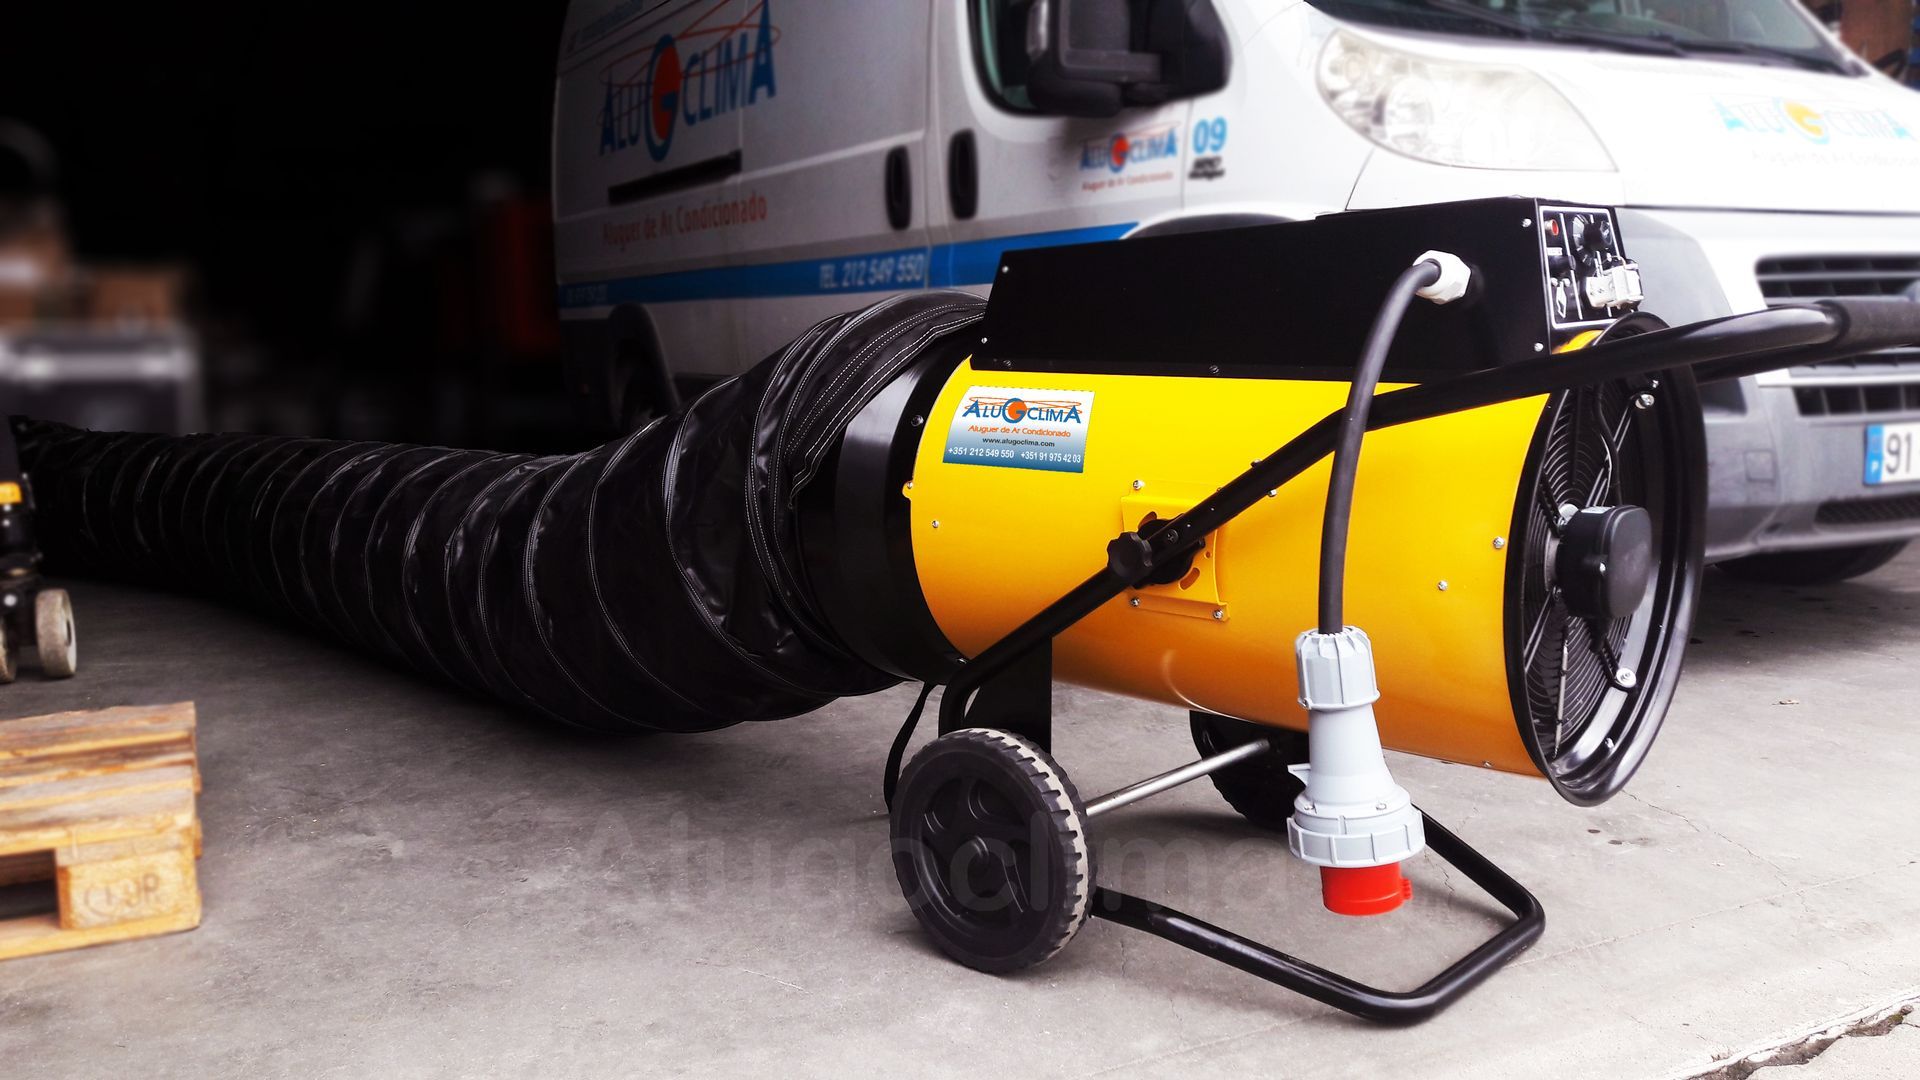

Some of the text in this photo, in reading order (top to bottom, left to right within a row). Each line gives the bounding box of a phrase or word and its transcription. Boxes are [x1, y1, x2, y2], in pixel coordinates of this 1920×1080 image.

[1193, 116, 1227, 154] 09
[841, 258, 867, 287] 212
[895, 253, 924, 283] 550
[968, 425, 1071, 438] Aluguer de Ar Condicionado
[982, 437, 1055, 448] www.alugoclima.com
[948, 447, 968, 456] +351
[970, 448, 984, 457] 212
[1000, 449, 1015, 459] 550
[1020, 451, 1038, 461] +351
[1039, 452, 1048, 461] 91
[1049, 452, 1062, 463] 975
[1062, 453, 1072, 463] 42
[1072, 454, 1081, 464] 03
[1886, 432, 1912, 475] 91
